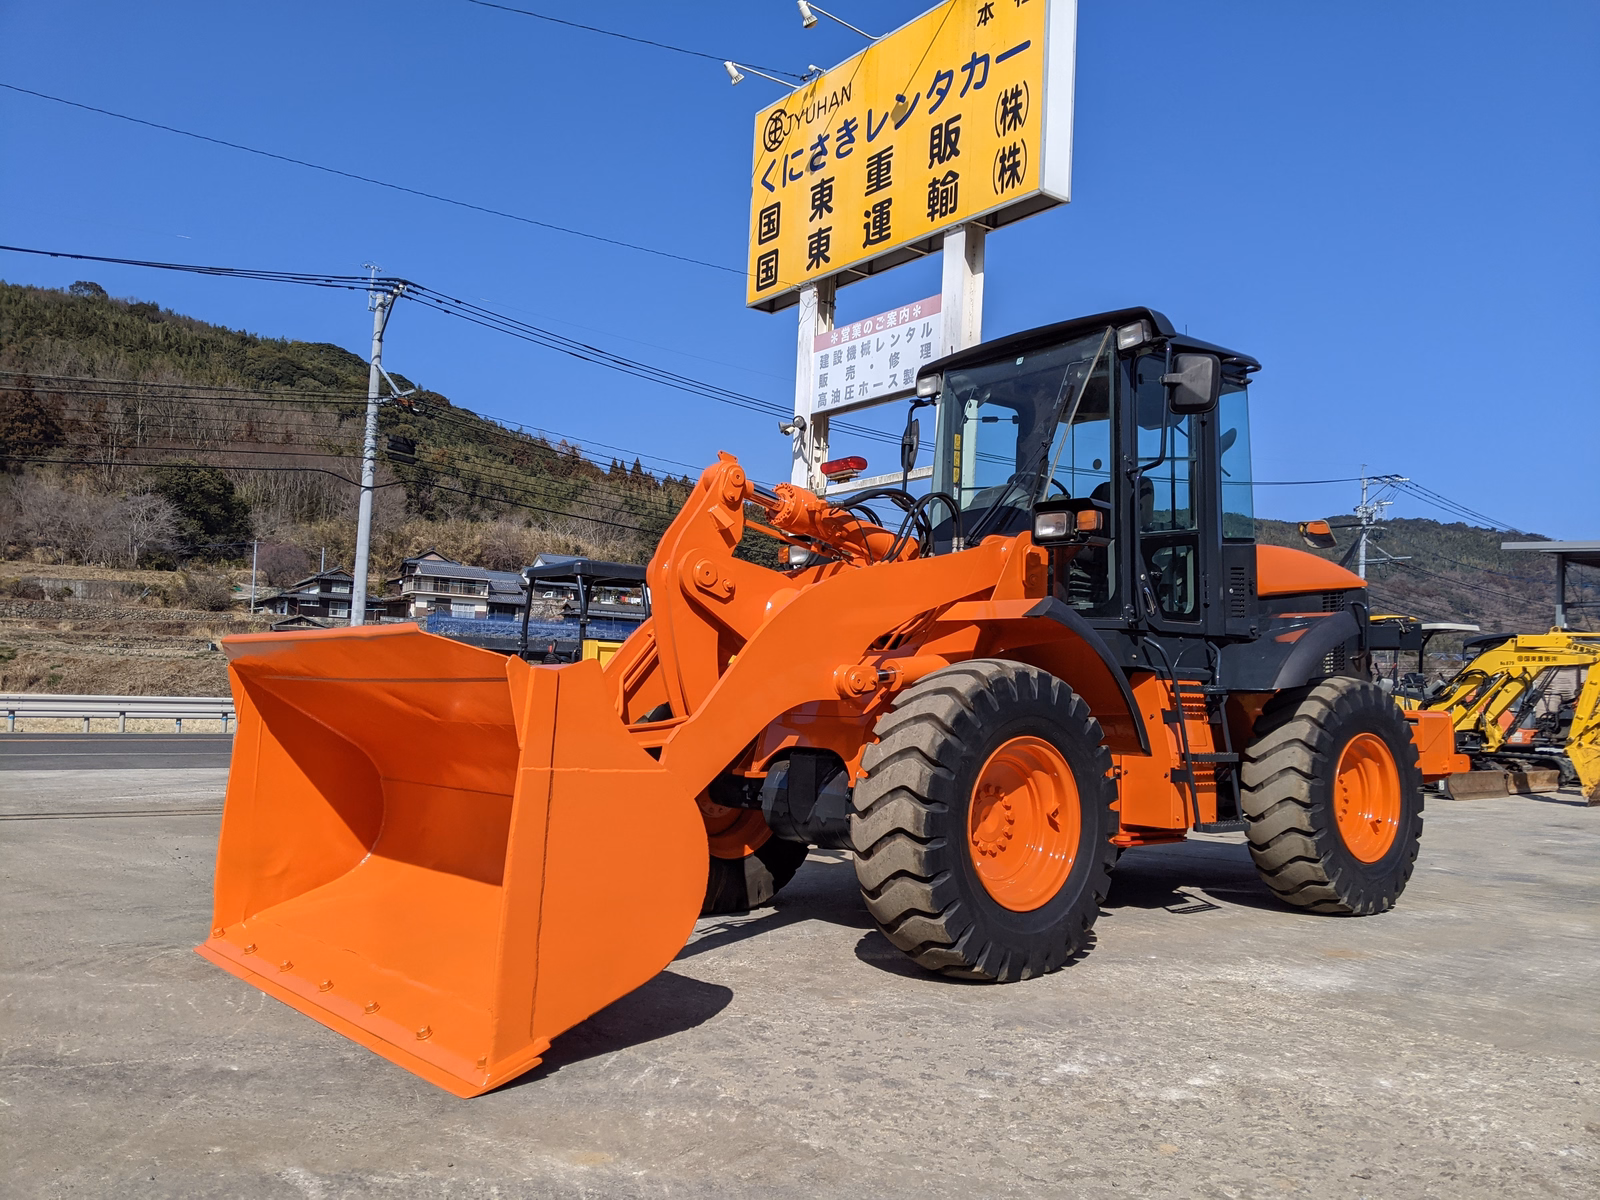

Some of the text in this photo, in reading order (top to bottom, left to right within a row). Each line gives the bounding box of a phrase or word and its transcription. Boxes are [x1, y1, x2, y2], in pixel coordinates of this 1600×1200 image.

[761, 40, 1031, 193] くにさきレンタカー
[783, 82, 852, 137] JYUHAN
[819, 322, 932, 370] 建設機械レンタル
[817, 366, 925, 408] 高油圧ホース製
